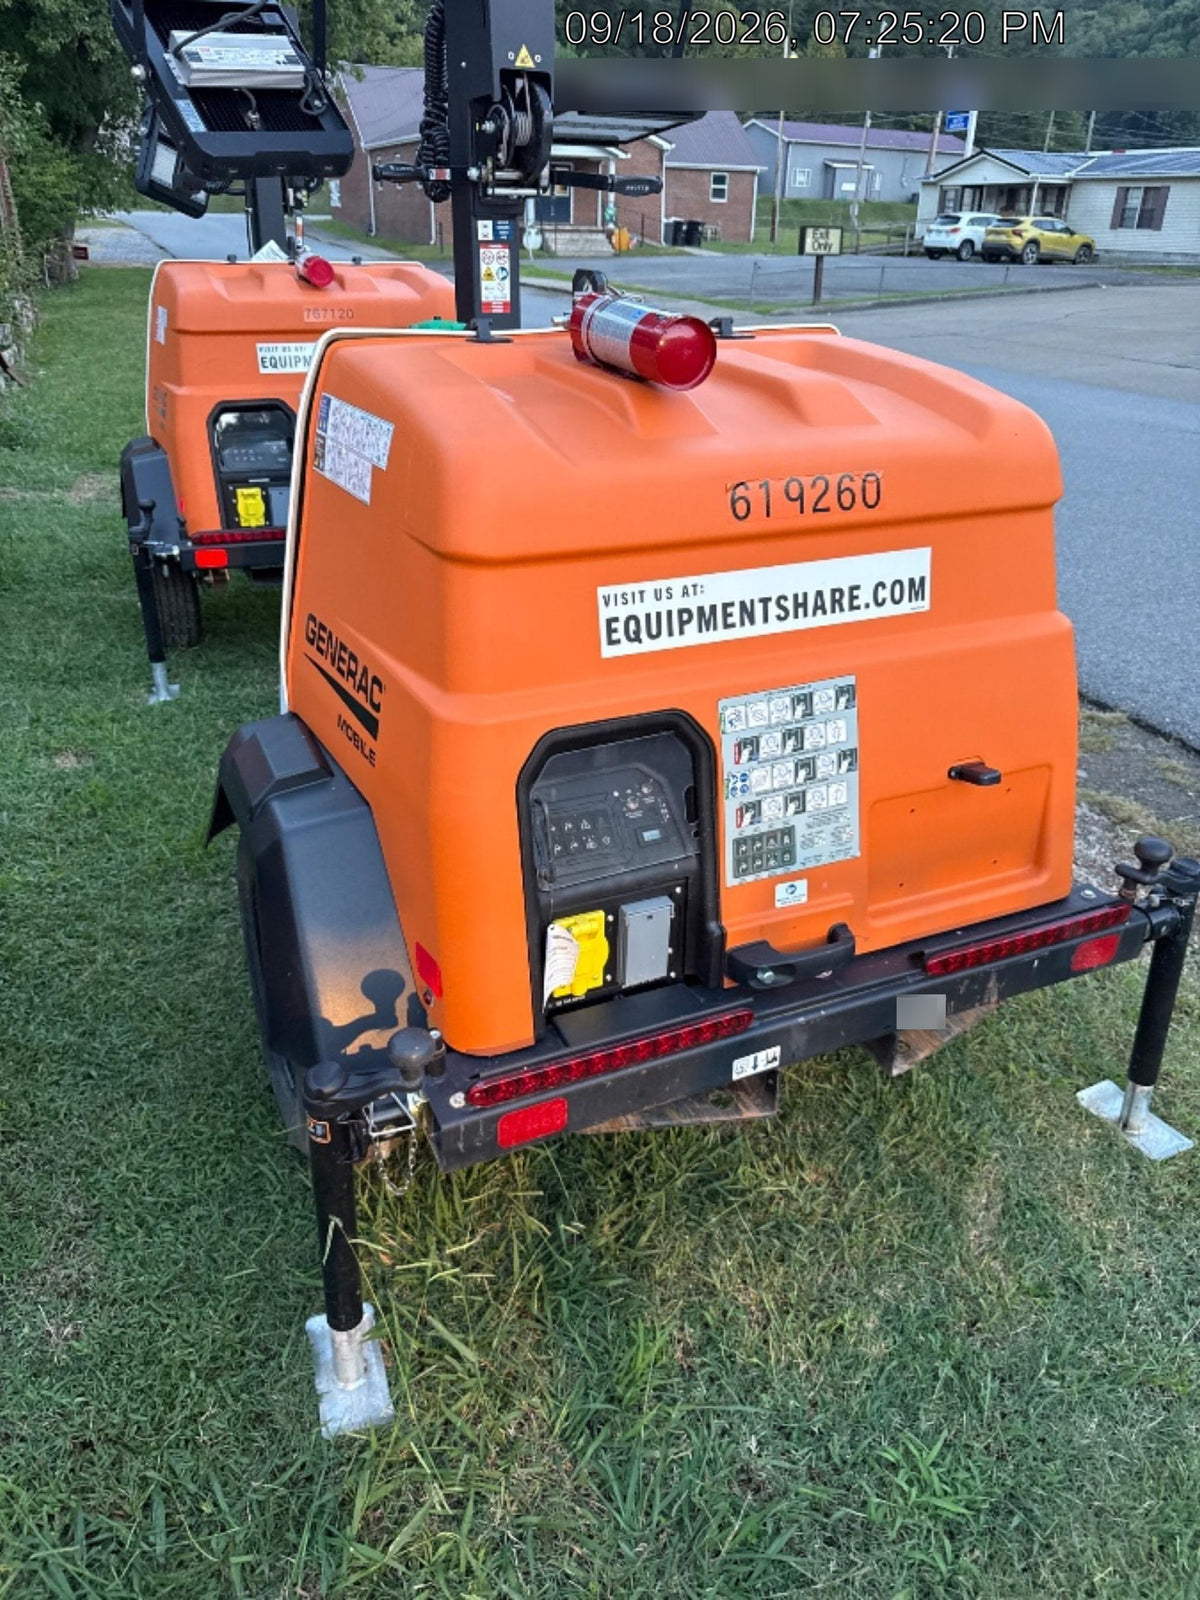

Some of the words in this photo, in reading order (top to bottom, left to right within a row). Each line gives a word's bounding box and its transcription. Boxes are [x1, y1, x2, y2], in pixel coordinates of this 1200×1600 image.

[812, 228, 830, 239] Exit
[812, 240, 833, 253] Only
[304, 308, 355, 320] 767120
[730, 472, 881, 521] 619260
[602, 589, 646, 608] VISIT
[654, 586, 673, 602] US
[681, 583, 705, 598] AT:
[605, 575, 926, 646] EQUIPMENTSHARE.COM
[305, 612, 384, 714] GENERAC
[337, 713, 376, 768] MOBILE
